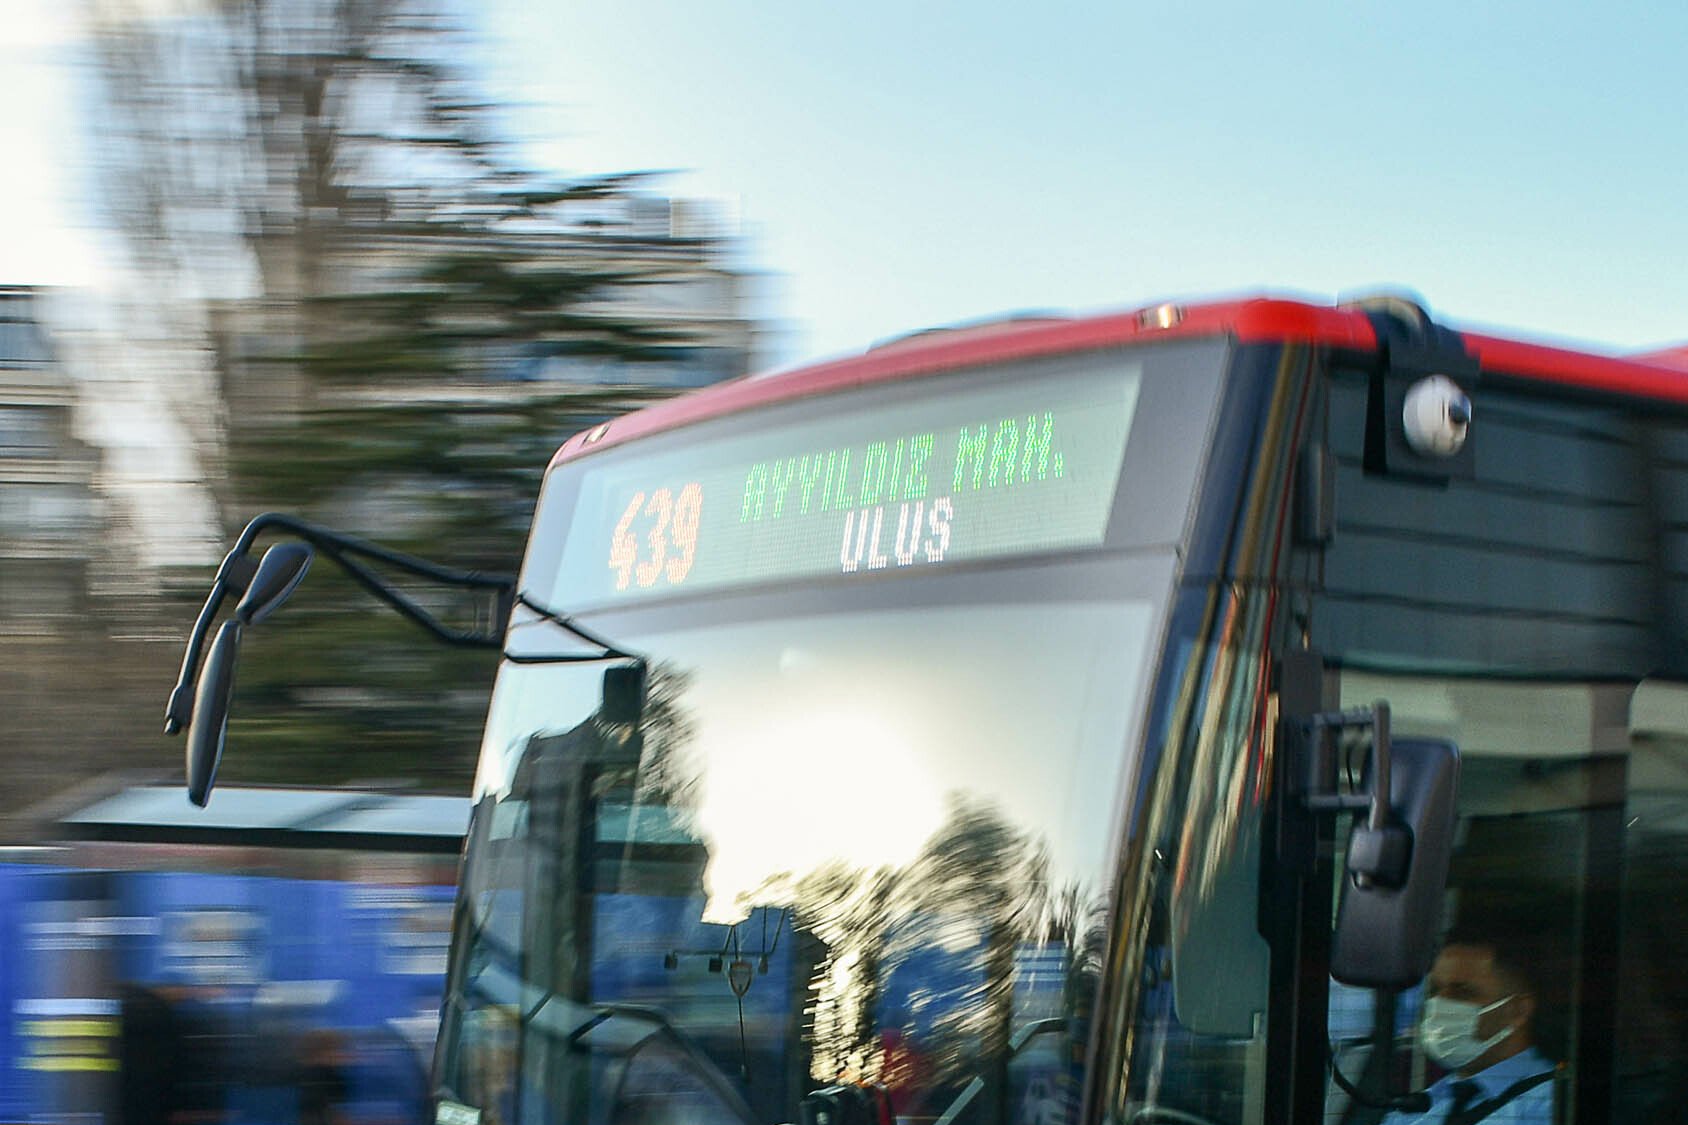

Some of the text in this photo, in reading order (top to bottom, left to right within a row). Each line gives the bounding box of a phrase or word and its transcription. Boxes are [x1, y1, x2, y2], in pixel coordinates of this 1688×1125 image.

[741, 433, 935, 521] AYYILDIZ
[608, 482, 703, 592] 439
[841, 498, 953, 573] ULUS
